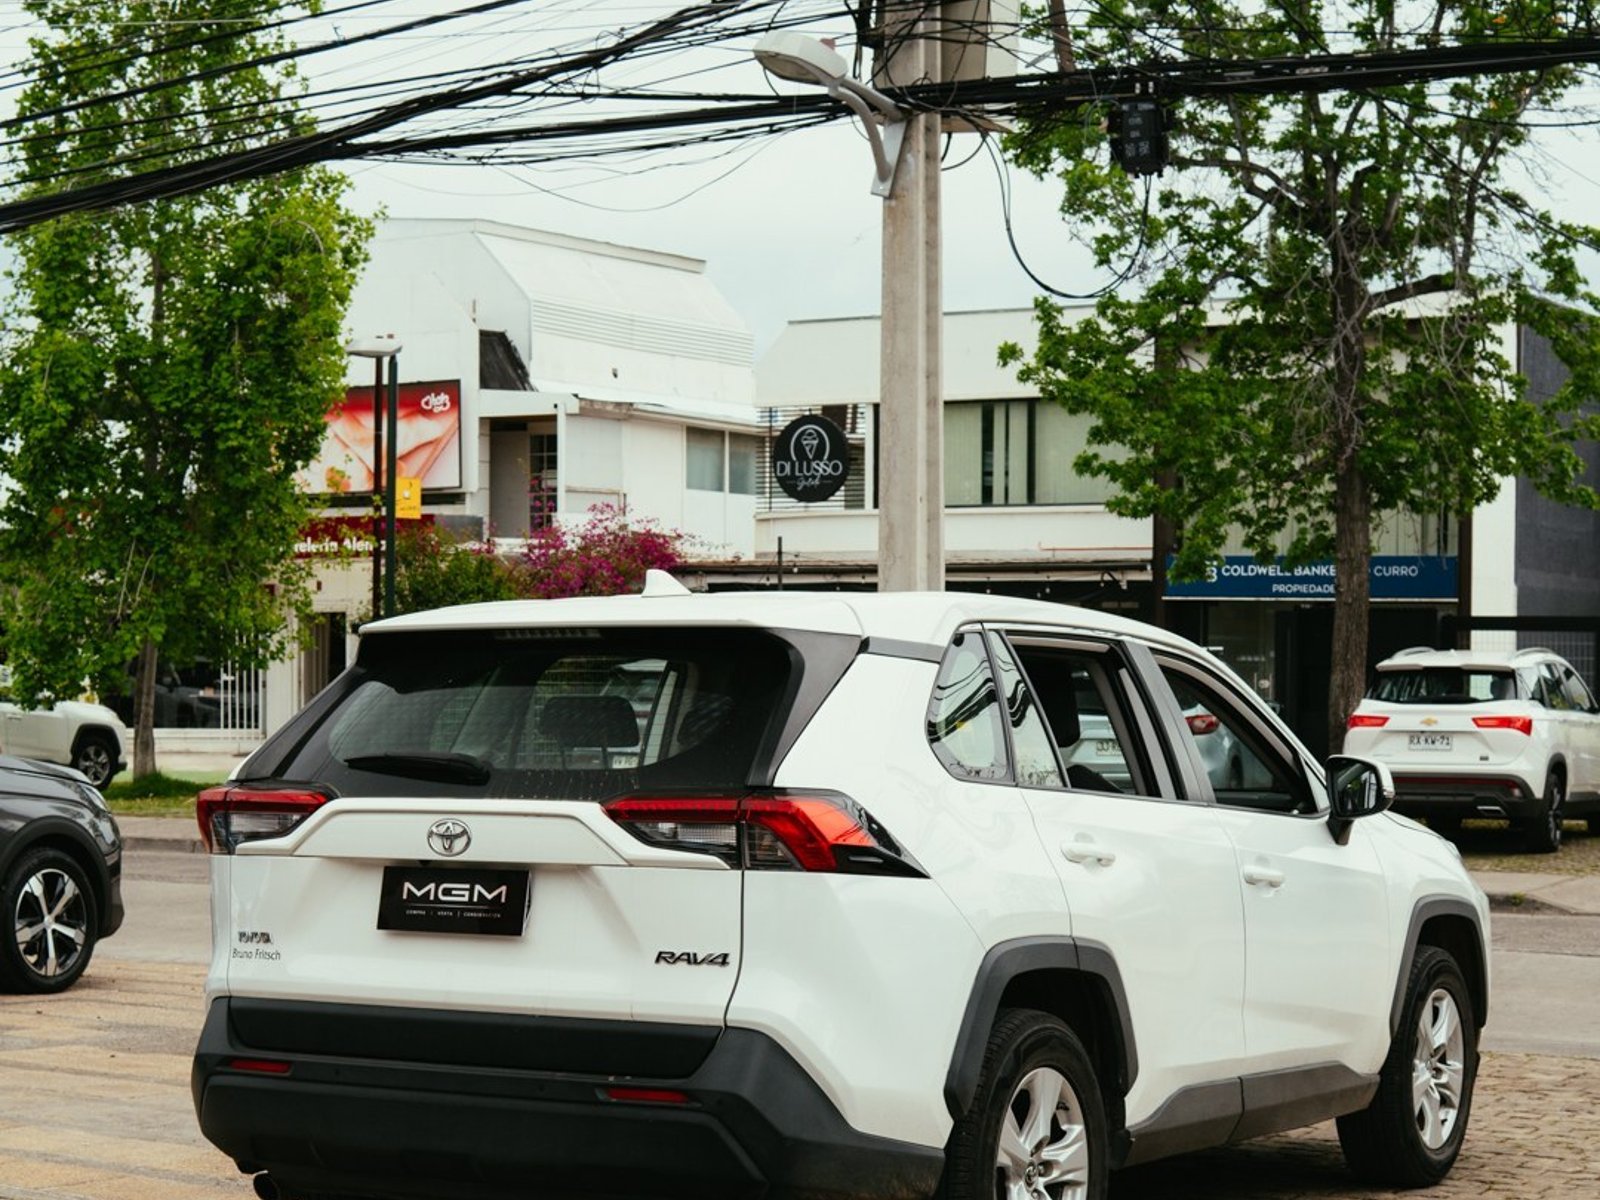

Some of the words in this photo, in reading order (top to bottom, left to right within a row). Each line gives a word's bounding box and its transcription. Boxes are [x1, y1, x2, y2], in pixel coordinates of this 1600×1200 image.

[776, 461, 791, 477] DI
[795, 460, 843, 477] LUSSO
[1293, 564, 1337, 576] BANKE
[1373, 565, 1418, 577] CURRO
[1272, 584, 1336, 594] PROPIEDADE
[403, 881, 507, 903] MGM
[232, 948, 253, 960] Bruno
[254, 948, 281, 961] Fritsch
[655, 951, 730, 967] RAV4
